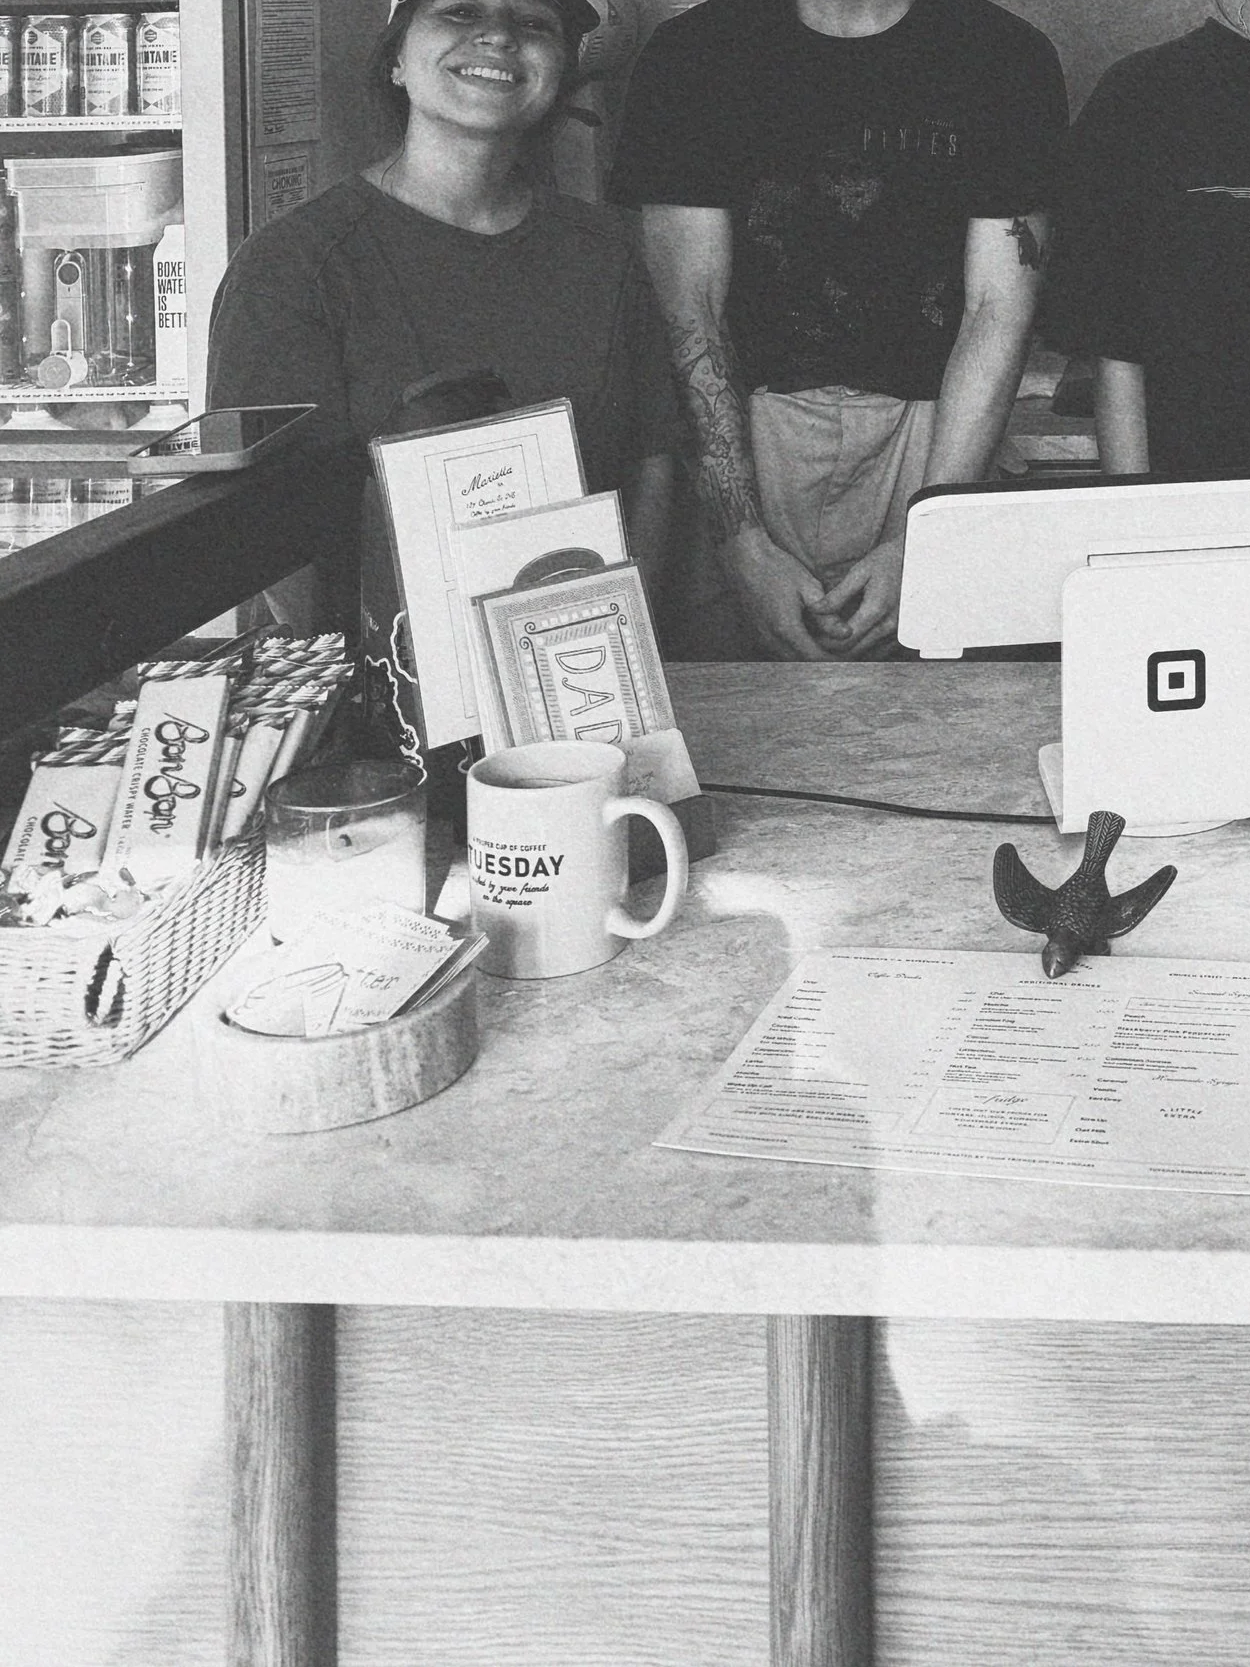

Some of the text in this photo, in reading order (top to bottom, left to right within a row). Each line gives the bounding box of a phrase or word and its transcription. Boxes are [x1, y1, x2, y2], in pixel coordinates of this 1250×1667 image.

[157, 278, 187, 294] WATE
[158, 295, 167, 311] IS
[132, 727, 151, 772] CHOCOLATE
[126, 772, 142, 802] CRISPY
[120, 801, 136, 831] WAFER
[14, 816, 38, 862] CHOCOLATE
[468, 844, 565, 878] TUESDAY
[519, 882, 550, 896] friends
